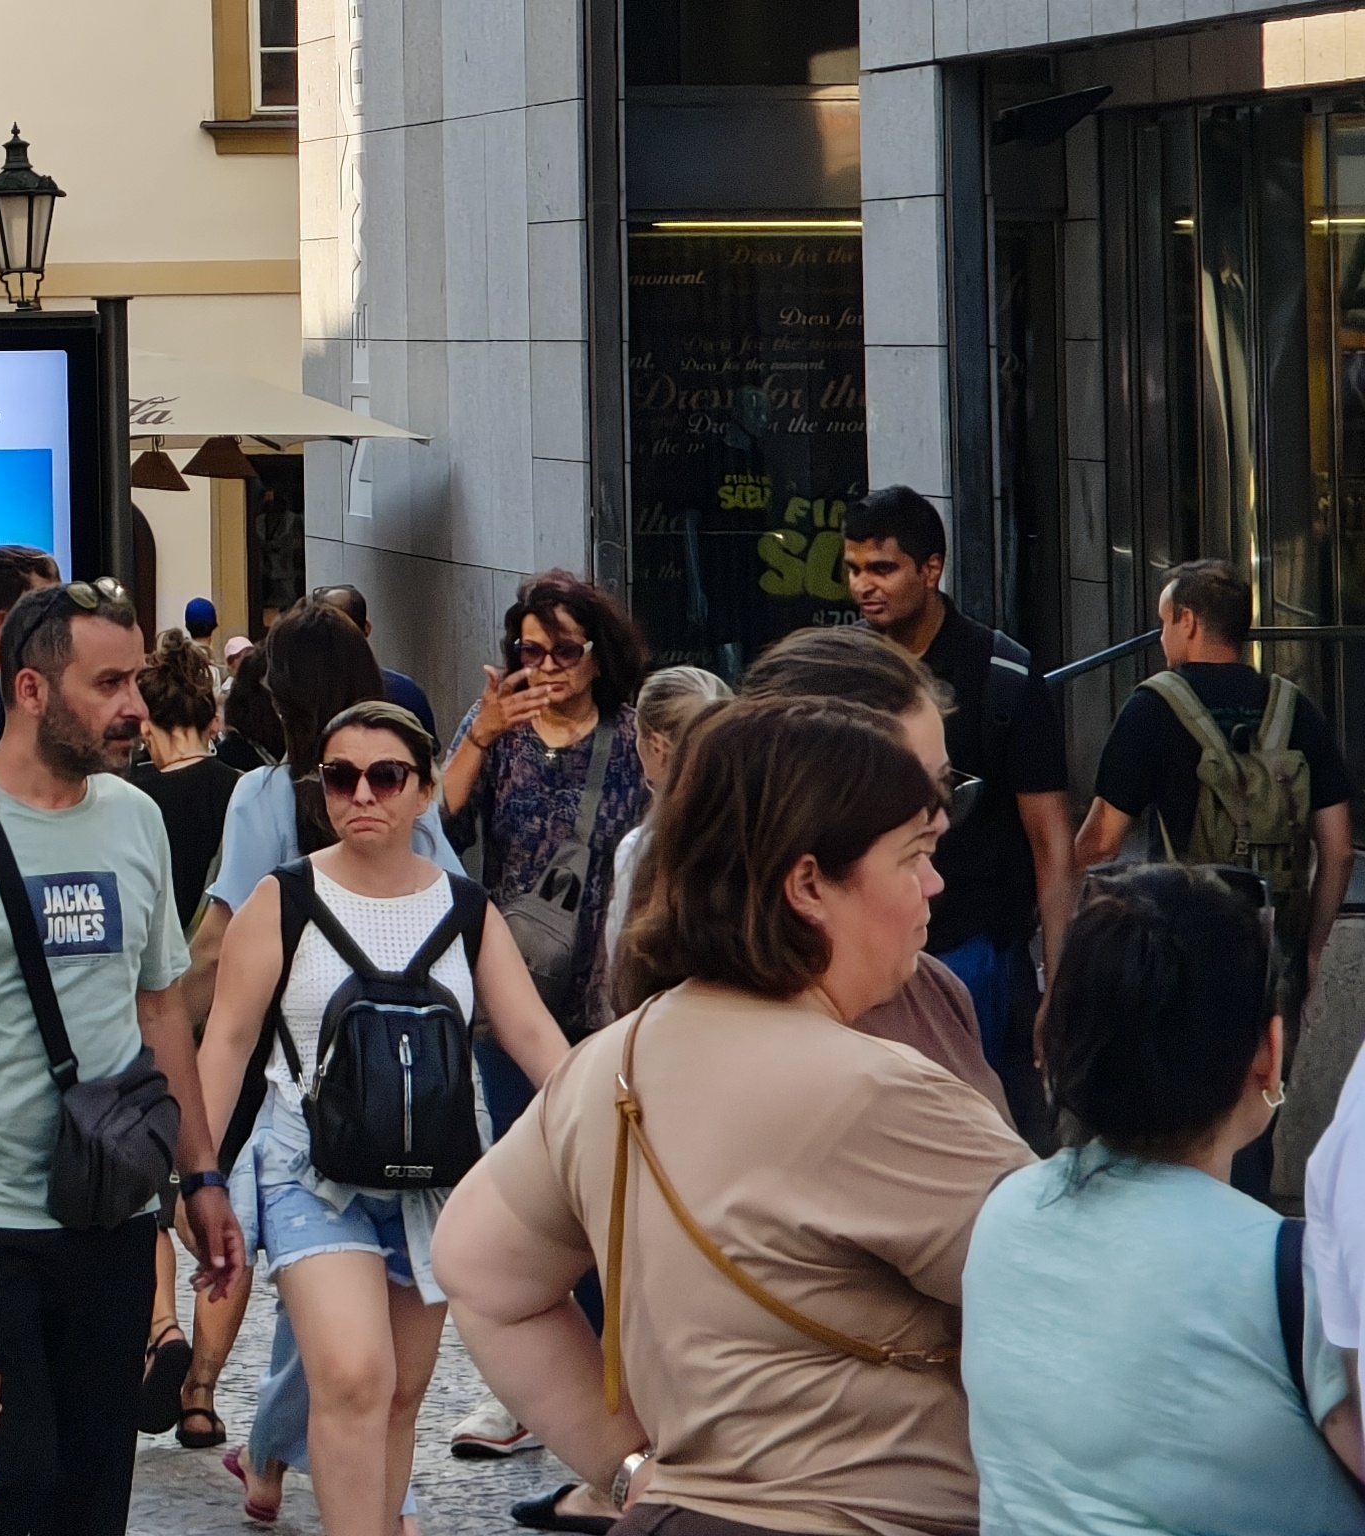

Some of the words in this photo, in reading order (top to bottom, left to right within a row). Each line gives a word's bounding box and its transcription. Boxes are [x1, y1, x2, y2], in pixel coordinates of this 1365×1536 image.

[819, 371, 864, 410] th
[43, 883, 105, 914] JACK&
[44, 913, 105, 945] JONES
[384, 1164, 434, 1179] GUESS
